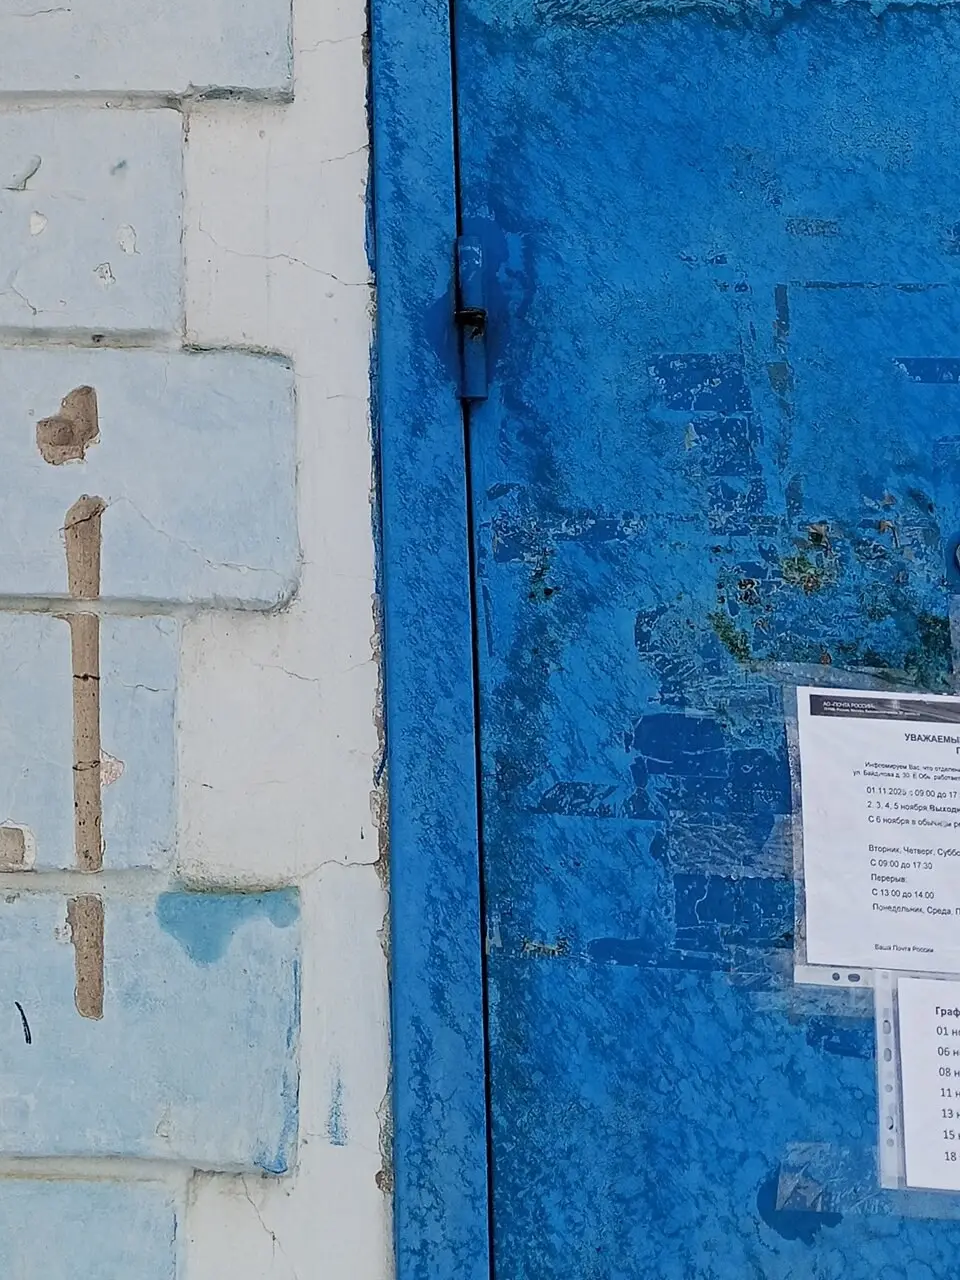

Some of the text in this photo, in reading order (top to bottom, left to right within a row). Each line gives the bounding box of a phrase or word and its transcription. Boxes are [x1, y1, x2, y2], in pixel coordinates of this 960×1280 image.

[893, 802, 899, 810] 5
[900, 803, 928, 812] ноября
[868, 815, 875, 823] С
[876, 815, 882, 823] 6
[883, 816, 910, 826] ноября
[870, 859, 877, 867] С
[901, 861, 911, 869] до
[871, 888, 878, 896] С
[902, 891, 912, 899] до
[892, 944, 911, 952] Почта
[936, 1026, 949, 1036] 01
[937, 1046, 950, 1056] 06
[938, 1067, 951, 1077] 08
[940, 1087, 952, 1098] 11
[941, 1108, 954, 1119] 13
[943, 1129, 955, 1140] 15
[944, 1151, 957, 1161] 18
